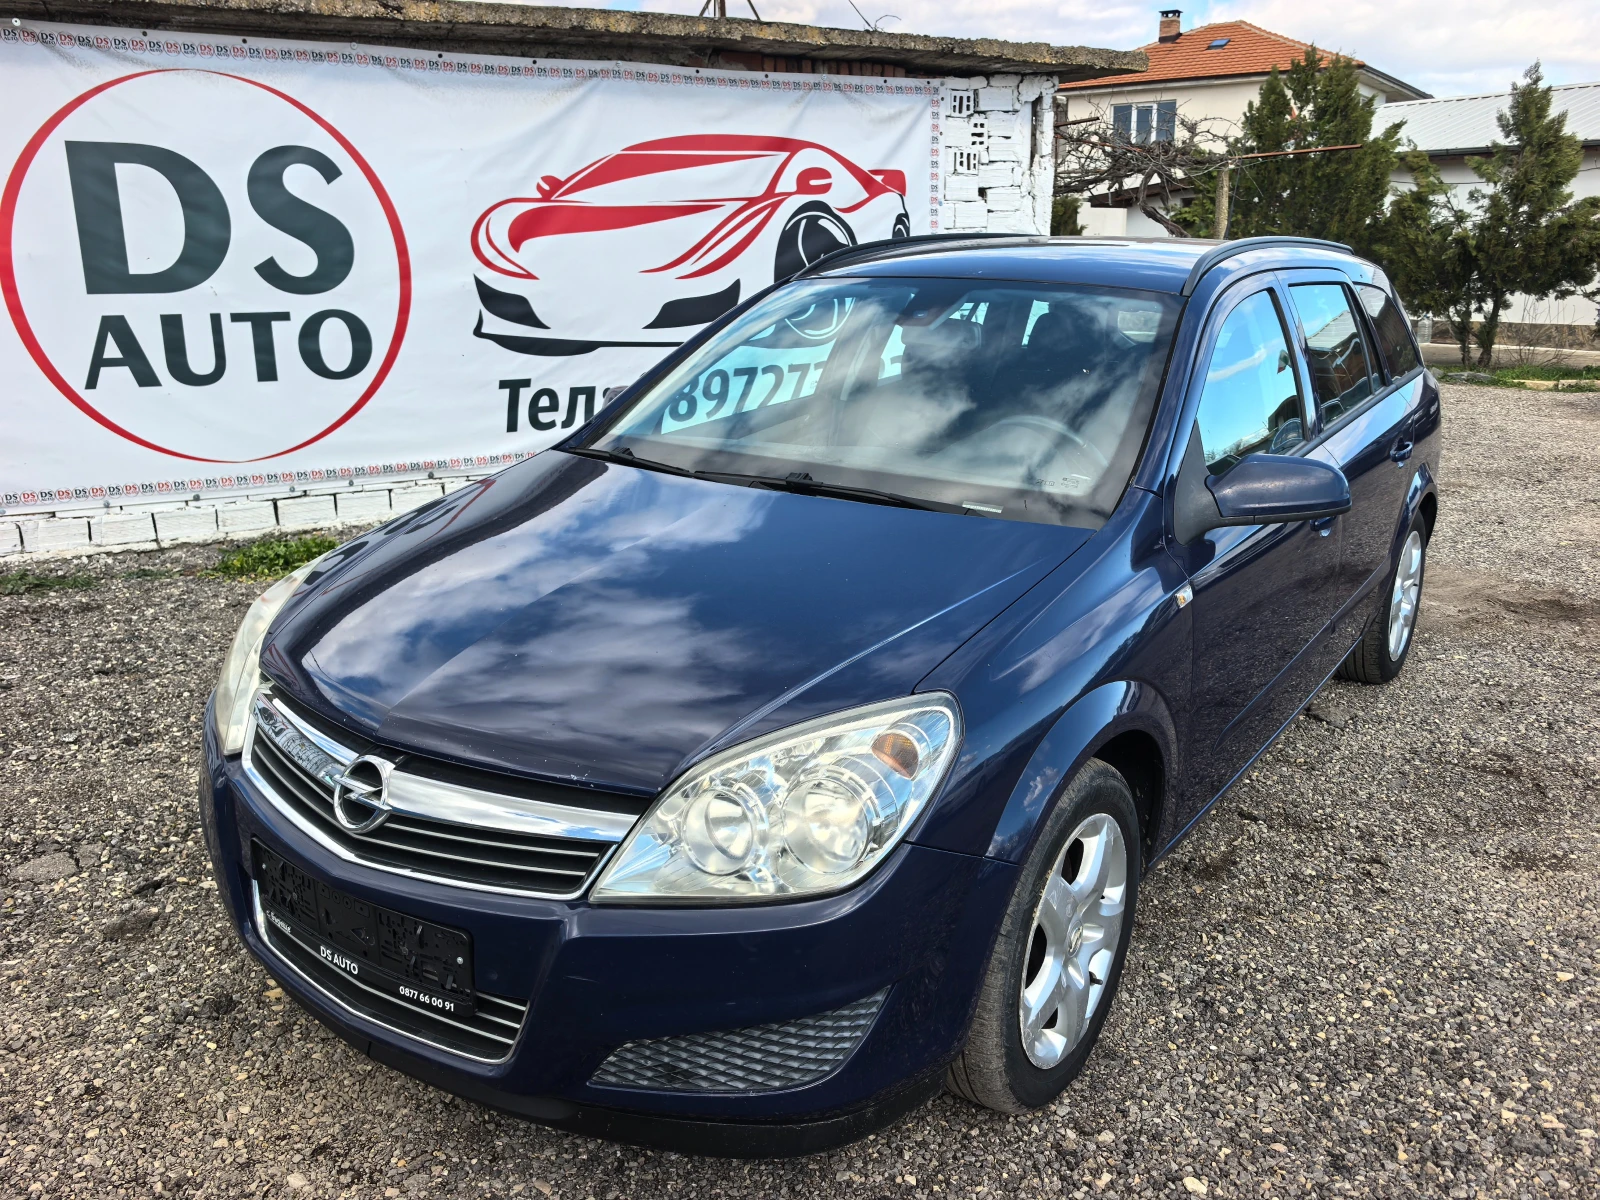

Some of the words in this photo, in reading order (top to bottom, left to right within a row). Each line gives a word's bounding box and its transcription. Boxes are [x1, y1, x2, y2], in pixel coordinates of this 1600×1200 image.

[3, 29, 17, 37] DS
[22, 30, 36, 38] DS
[41, 32, 54, 41] DS
[59, 33, 72, 42] DS
[78, 36, 91, 44] DS
[96, 37, 109, 46] DS
[114, 38, 126, 47] DS
[149, 40, 162, 49] DS
[64, 140, 355, 295] DS
[85, 309, 373, 390] AUTO
[320, 945, 332, 962] DS
[334, 954, 358, 974] AUTO
[399, 986, 418, 1000] 0877
[420, 991, 430, 1003] 66
[432, 995, 442, 1007] 00
[445, 1000, 454, 1012] 91
